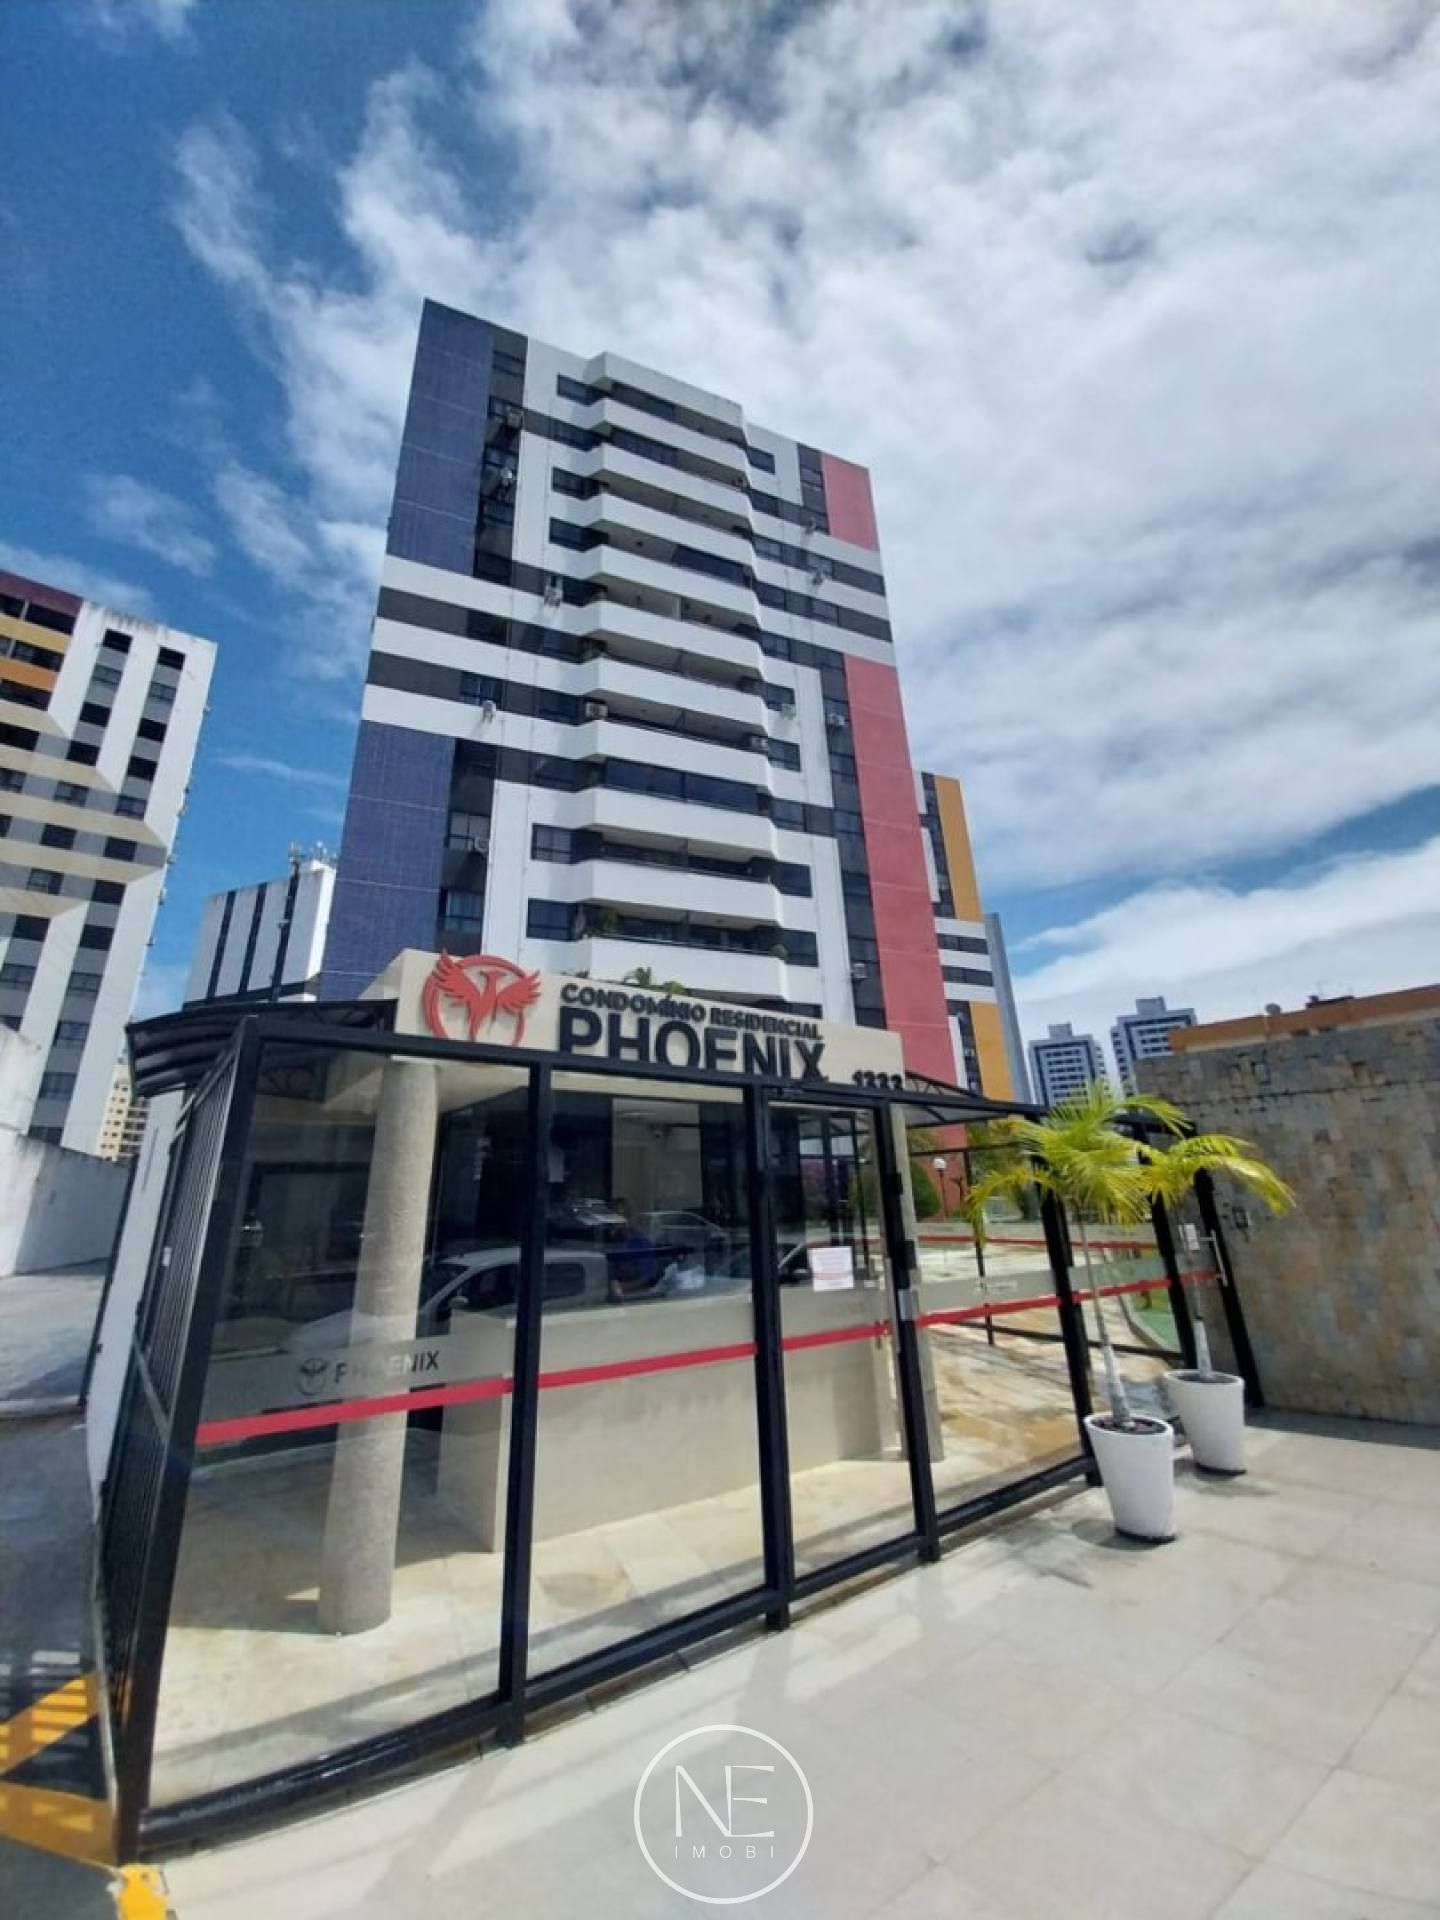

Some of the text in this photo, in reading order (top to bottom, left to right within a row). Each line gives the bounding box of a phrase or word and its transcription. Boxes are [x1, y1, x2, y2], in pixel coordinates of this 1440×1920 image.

[560, 983, 823, 1041] CONDOMÍNIO RESIDENCIAL
[558, 1004, 829, 1084] PHOENIX
[335, 1350, 440, 1384] PENIX
